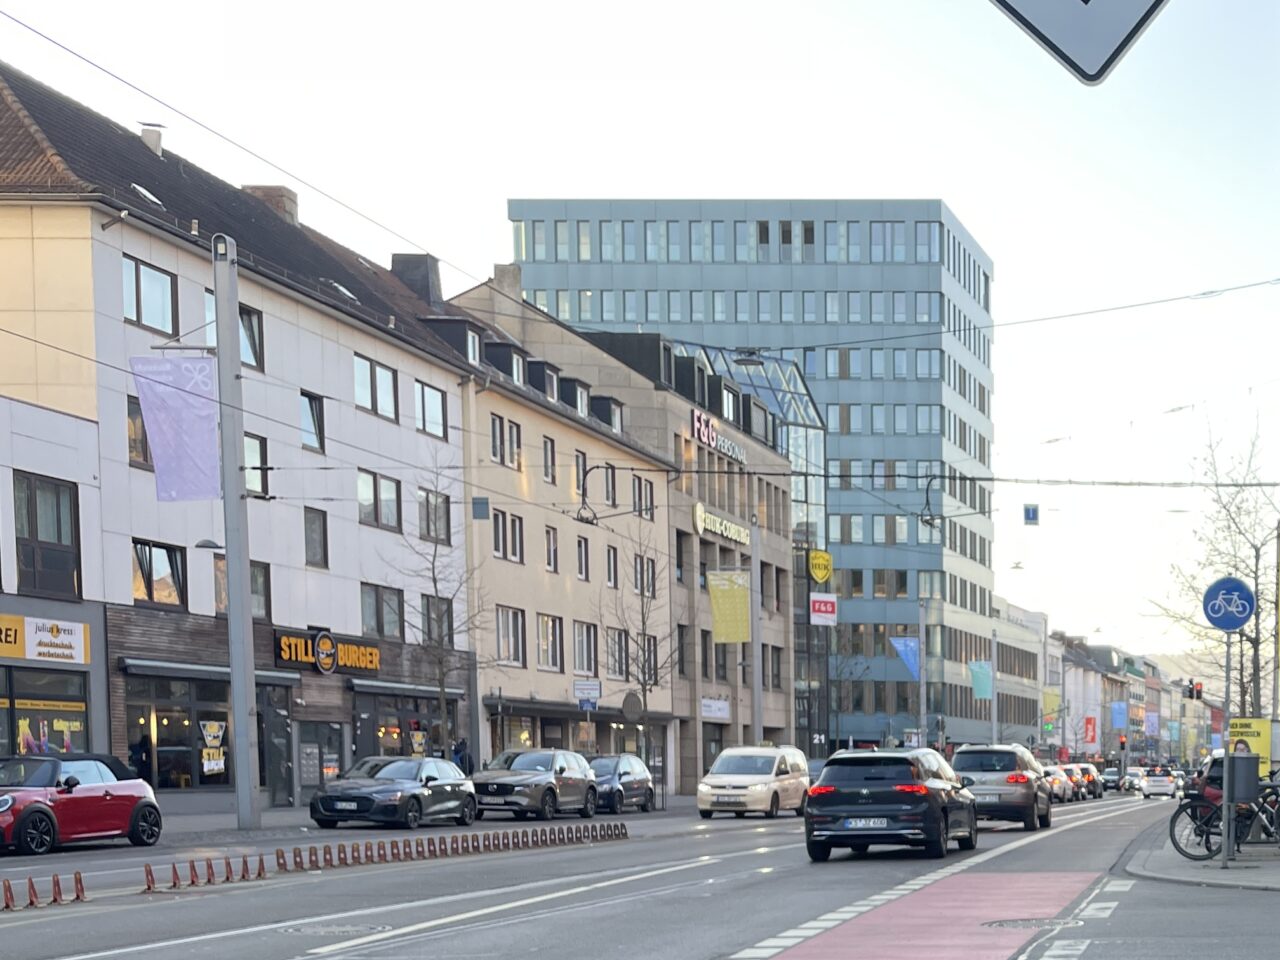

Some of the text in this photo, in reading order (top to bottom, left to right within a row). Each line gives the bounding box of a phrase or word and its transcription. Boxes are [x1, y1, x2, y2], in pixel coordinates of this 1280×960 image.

[692, 408, 748, 465] F&G PERSONAL
[705, 512, 750, 545] HUK-COBURG
[815, 602, 833, 612] F&G
[280, 635, 381, 670] STILL BURGER
[812, 733, 825, 744] 21
